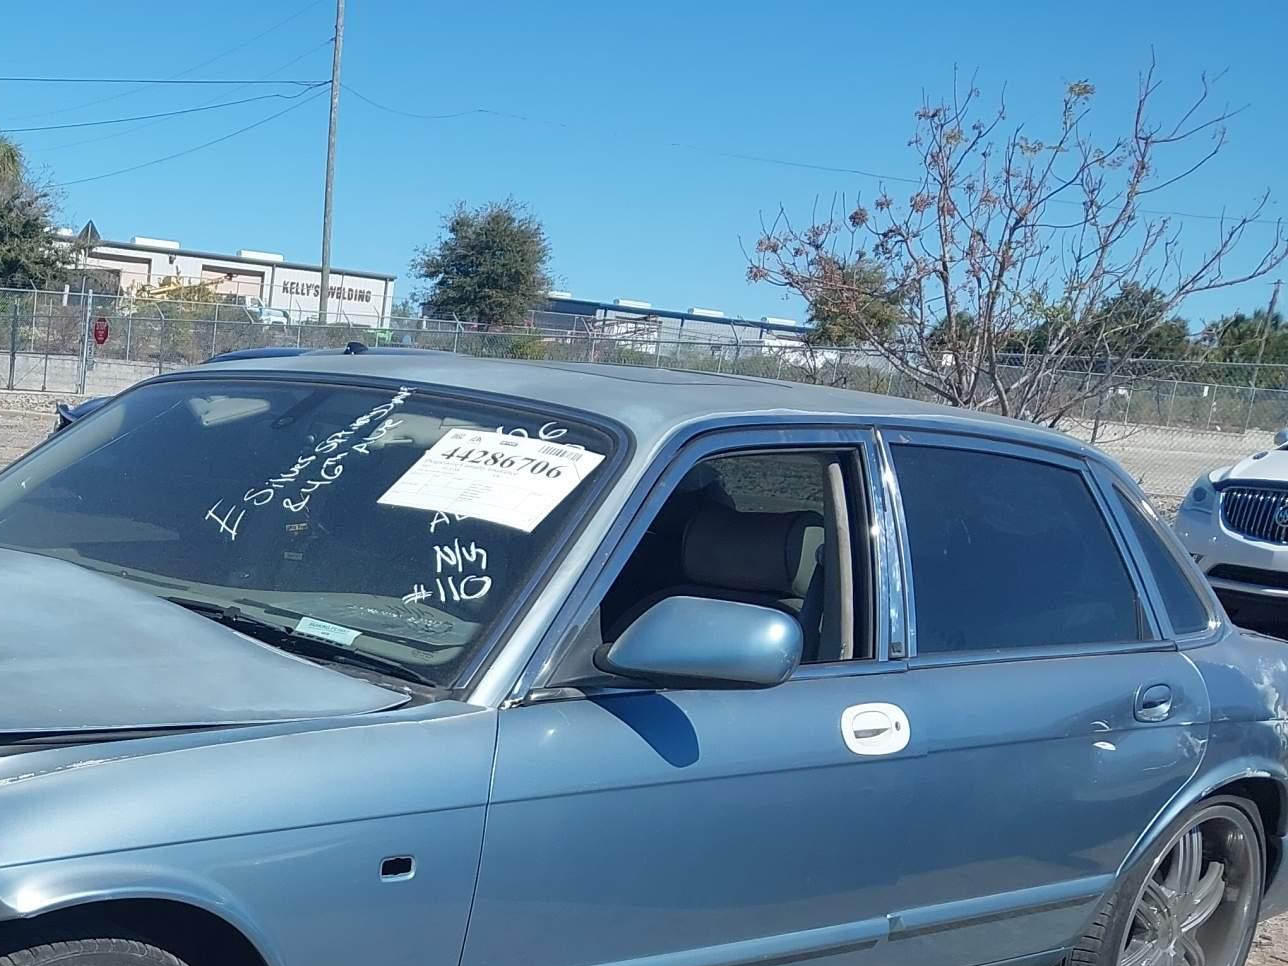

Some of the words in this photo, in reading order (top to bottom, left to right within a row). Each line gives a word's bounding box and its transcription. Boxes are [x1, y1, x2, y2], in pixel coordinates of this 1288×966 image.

[282, 280, 320, 298] KELLY'S
[328, 286, 372, 303] WELDING
[441, 446, 568, 479] 44286706
[205, 498, 246, 541] E
[402, 575, 492, 604] #110
